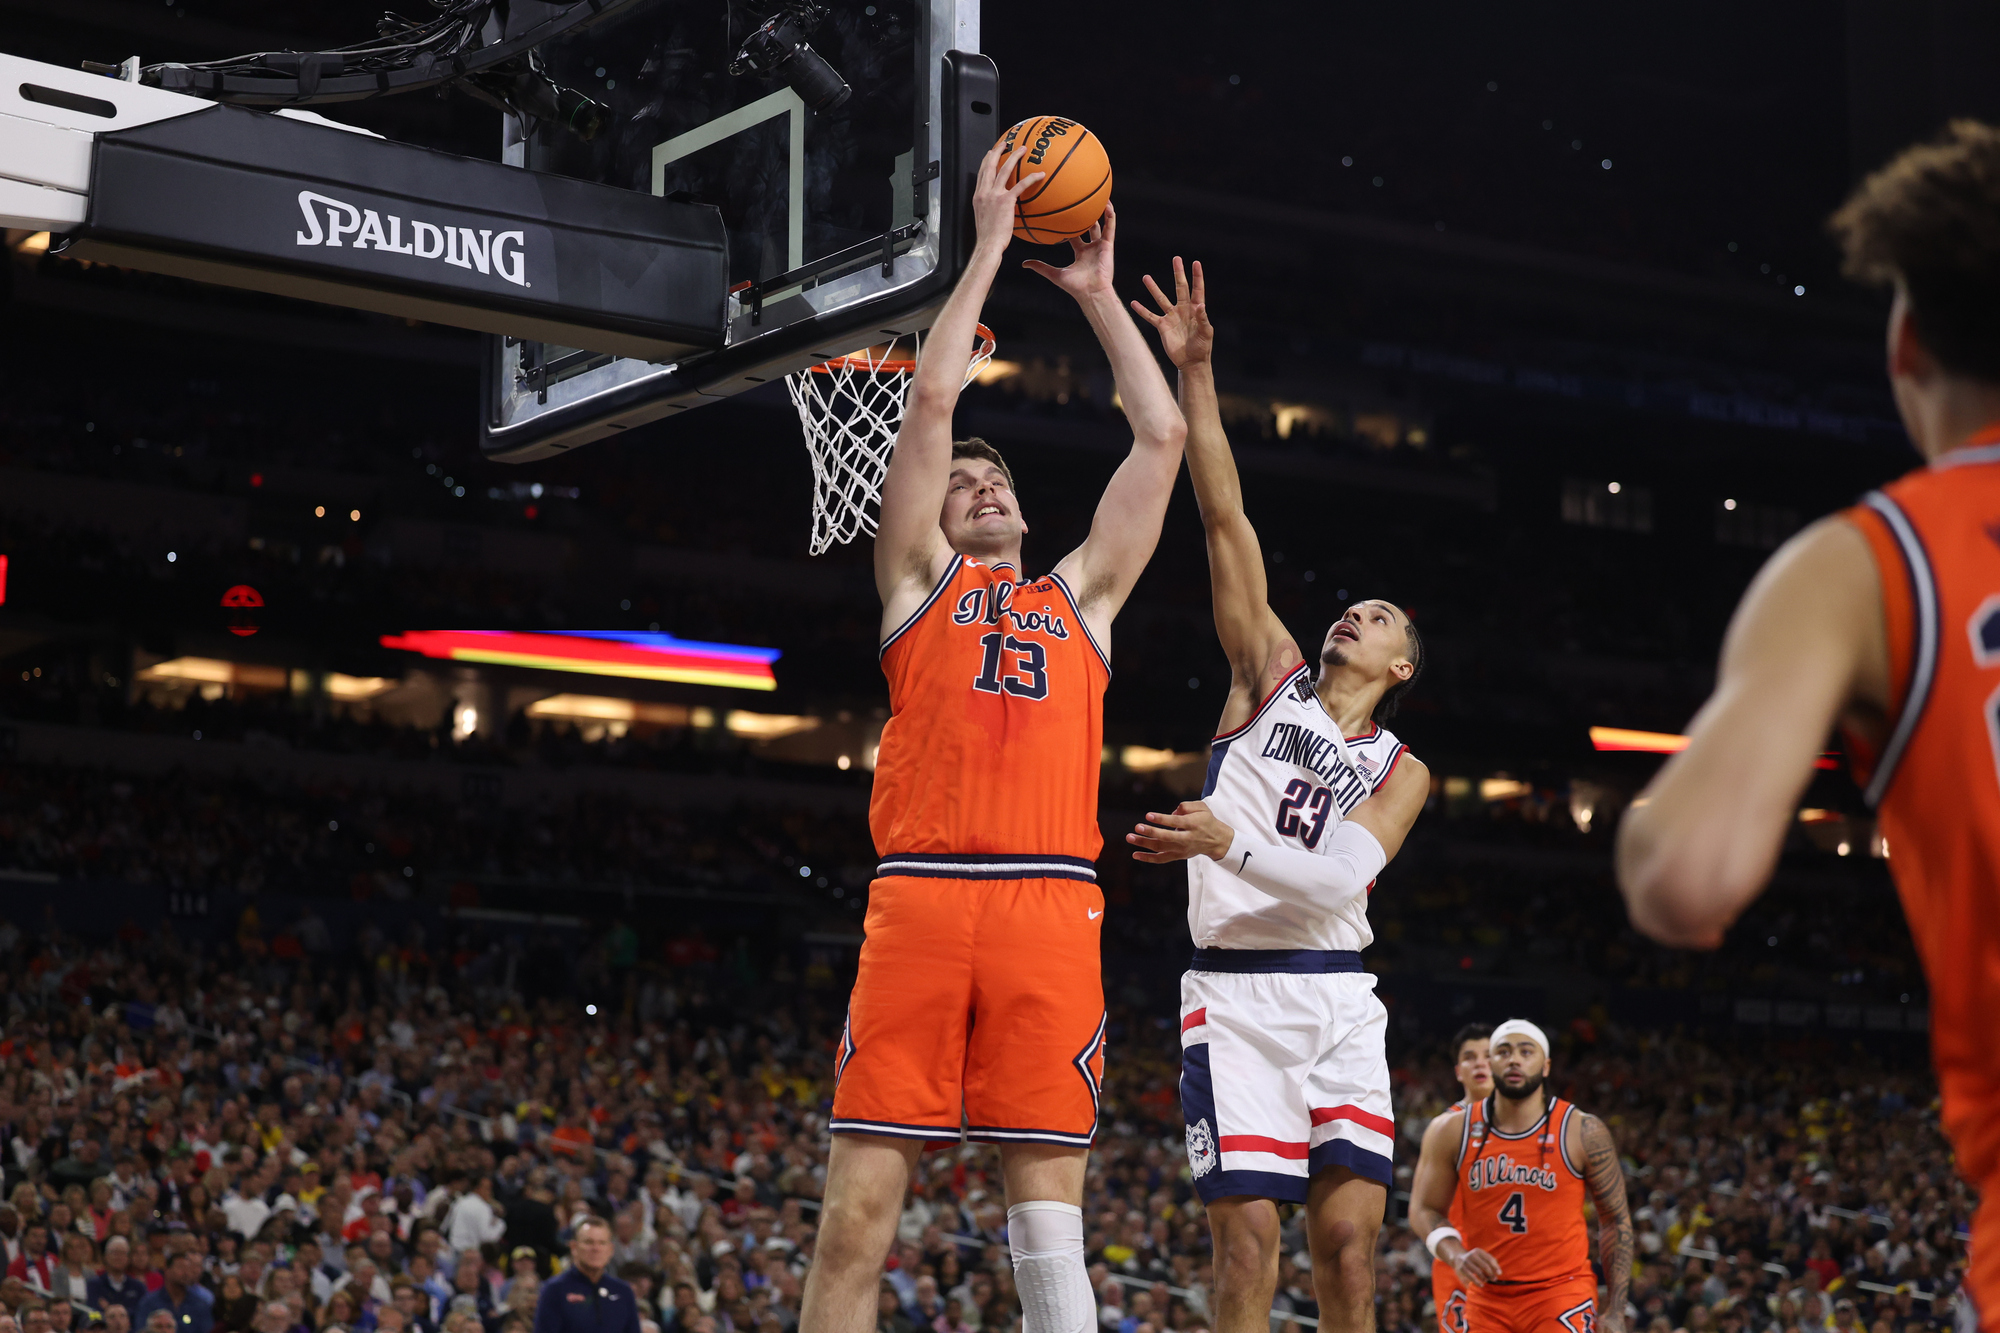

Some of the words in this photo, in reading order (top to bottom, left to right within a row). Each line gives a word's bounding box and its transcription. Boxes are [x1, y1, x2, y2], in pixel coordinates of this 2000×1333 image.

[296, 190, 525, 287] SPALDING
[973, 632, 1050, 701] 13
[1275, 778, 1332, 849] 23
[1469, 1154, 1557, 1191] Illinois
[1497, 1192, 1528, 1234] 4
